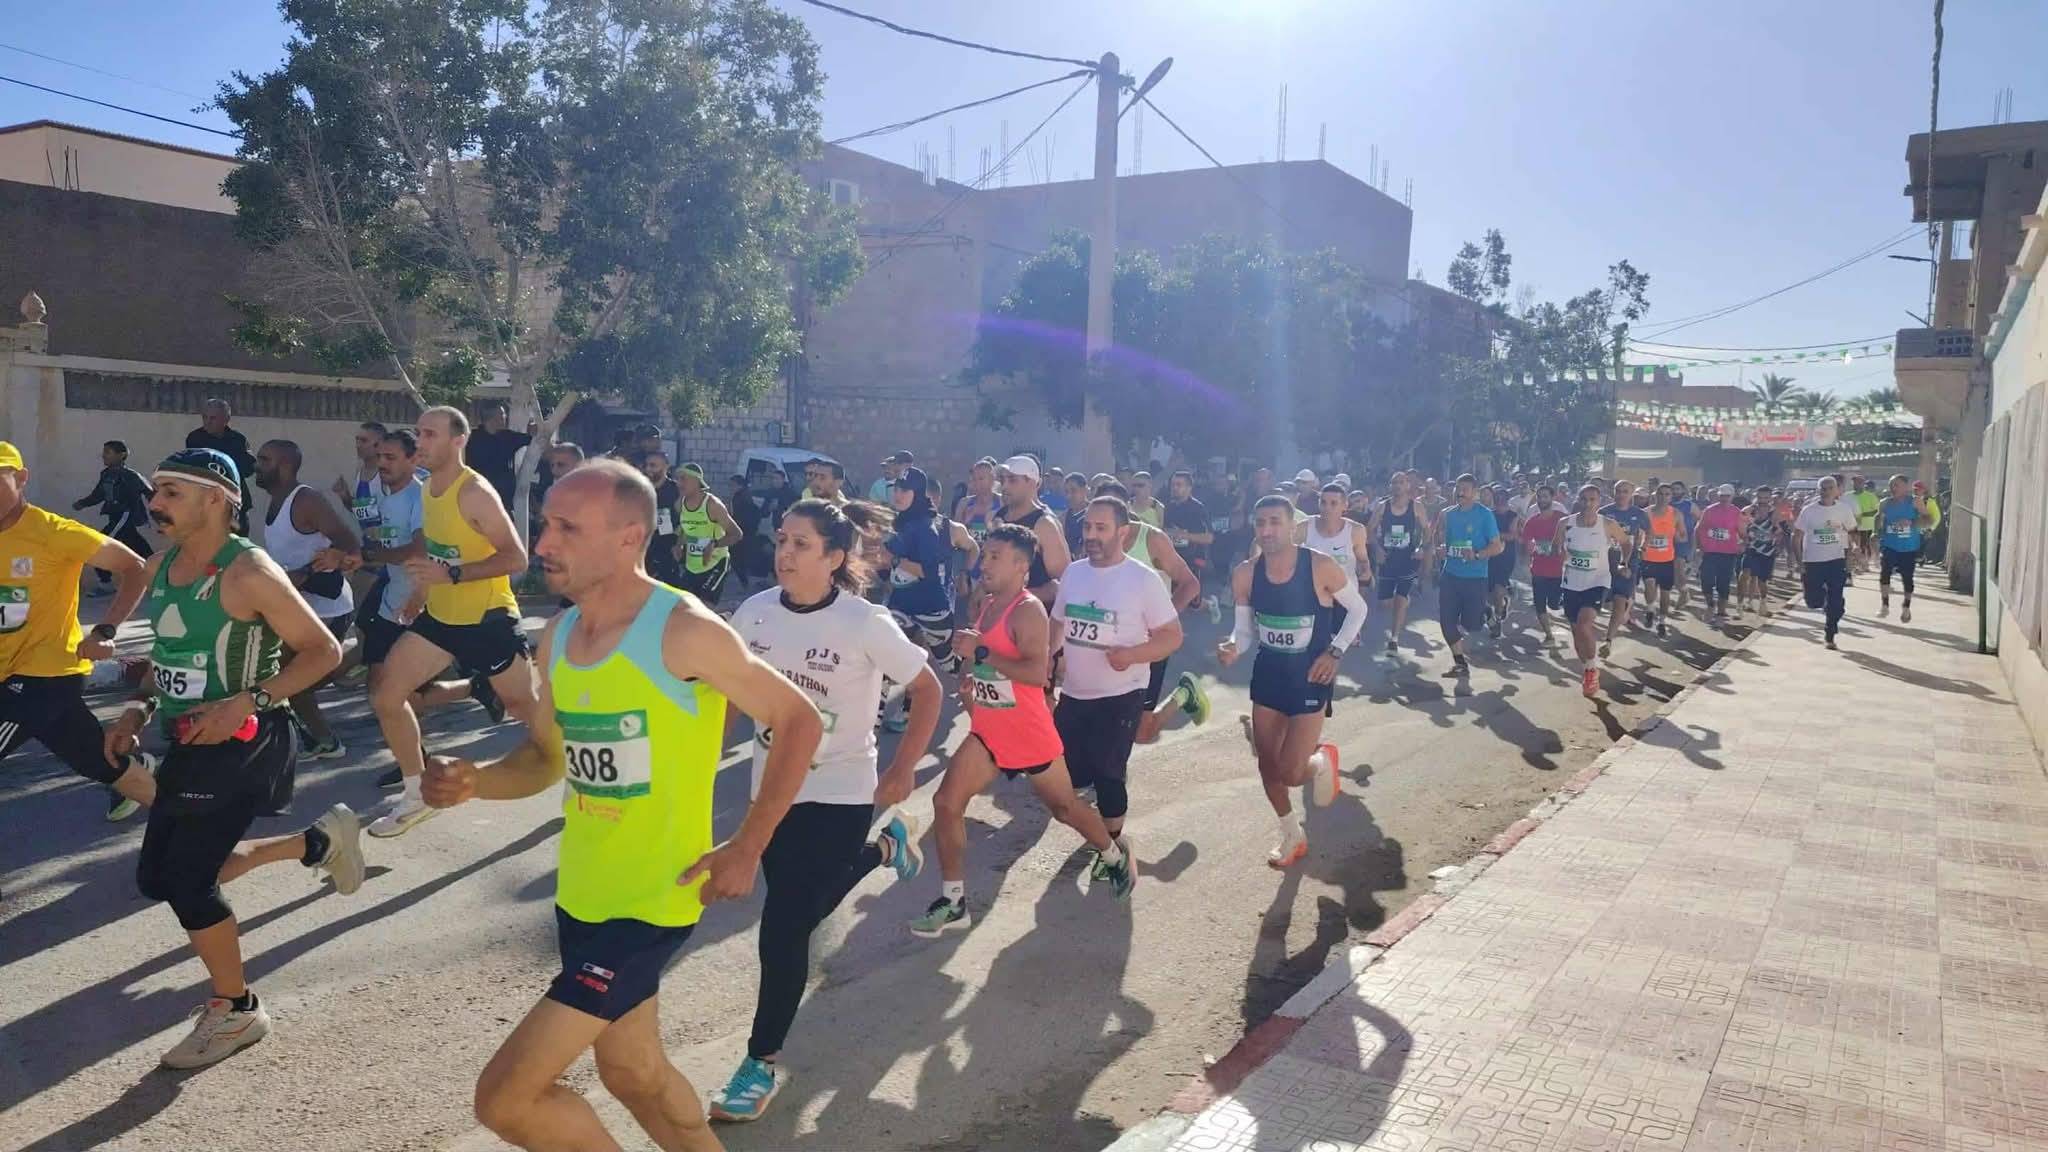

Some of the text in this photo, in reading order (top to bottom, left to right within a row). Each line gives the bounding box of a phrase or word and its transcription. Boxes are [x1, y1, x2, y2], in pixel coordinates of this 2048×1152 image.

[1571, 558, 1590, 568] 523
[1070, 620, 1098, 641] 373
[1267, 631, 1294, 646] 048
[776, 668, 829, 697] RATHON
[565, 745, 618, 783] 308
